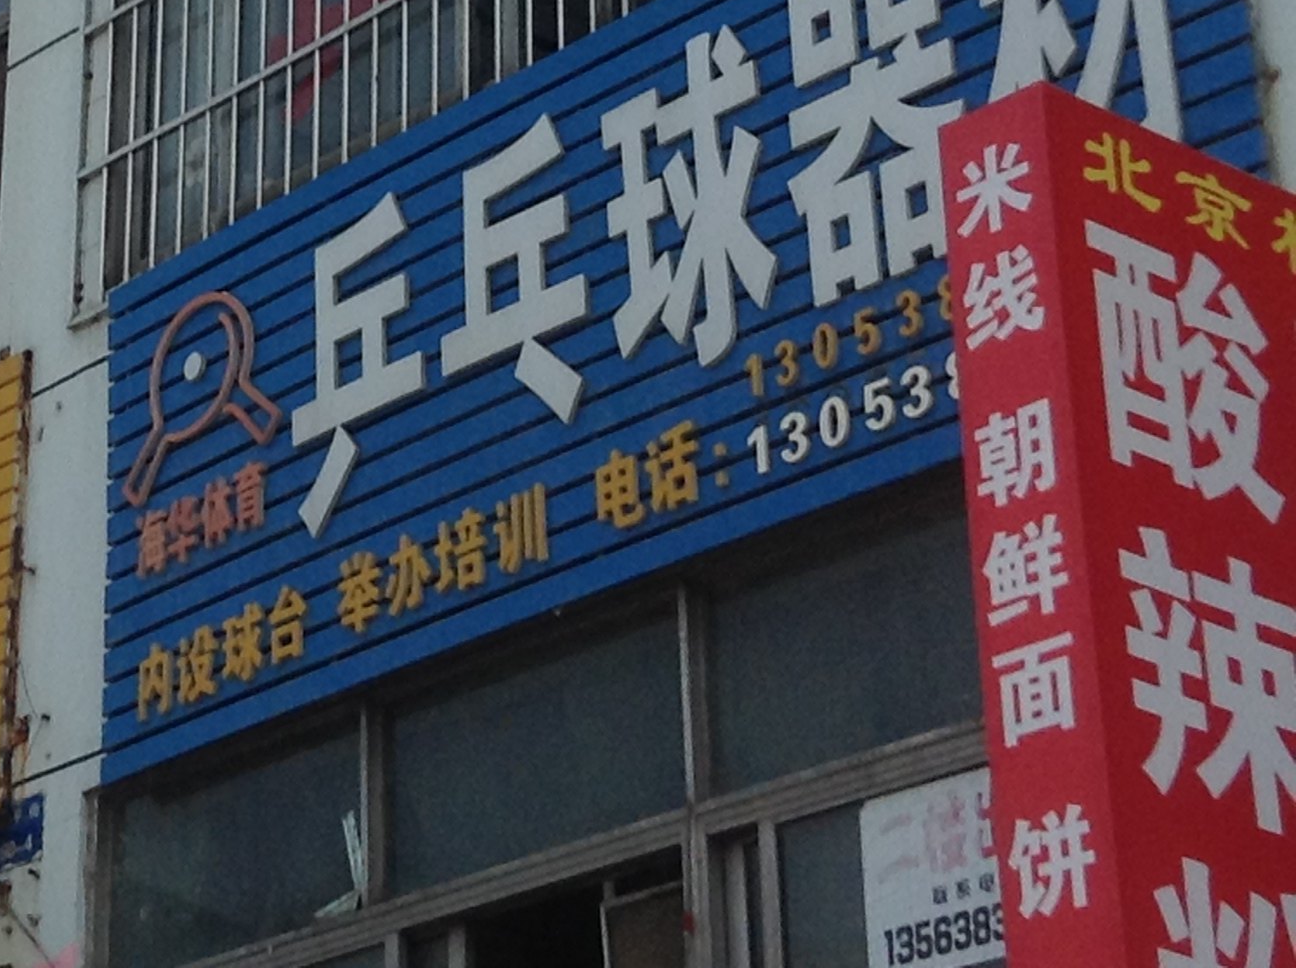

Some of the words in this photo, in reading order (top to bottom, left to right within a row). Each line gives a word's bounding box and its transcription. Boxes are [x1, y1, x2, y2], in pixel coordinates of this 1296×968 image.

[956, 142, 1046, 351] 米线
[136, 462, 267, 580] 海华体育
[137, 585, 309, 722] 内设球台
[337, 482, 550, 633] 举办培训
[973, 397, 1075, 748] 朝鲜面
[1008, 803, 1095, 919] 饼
